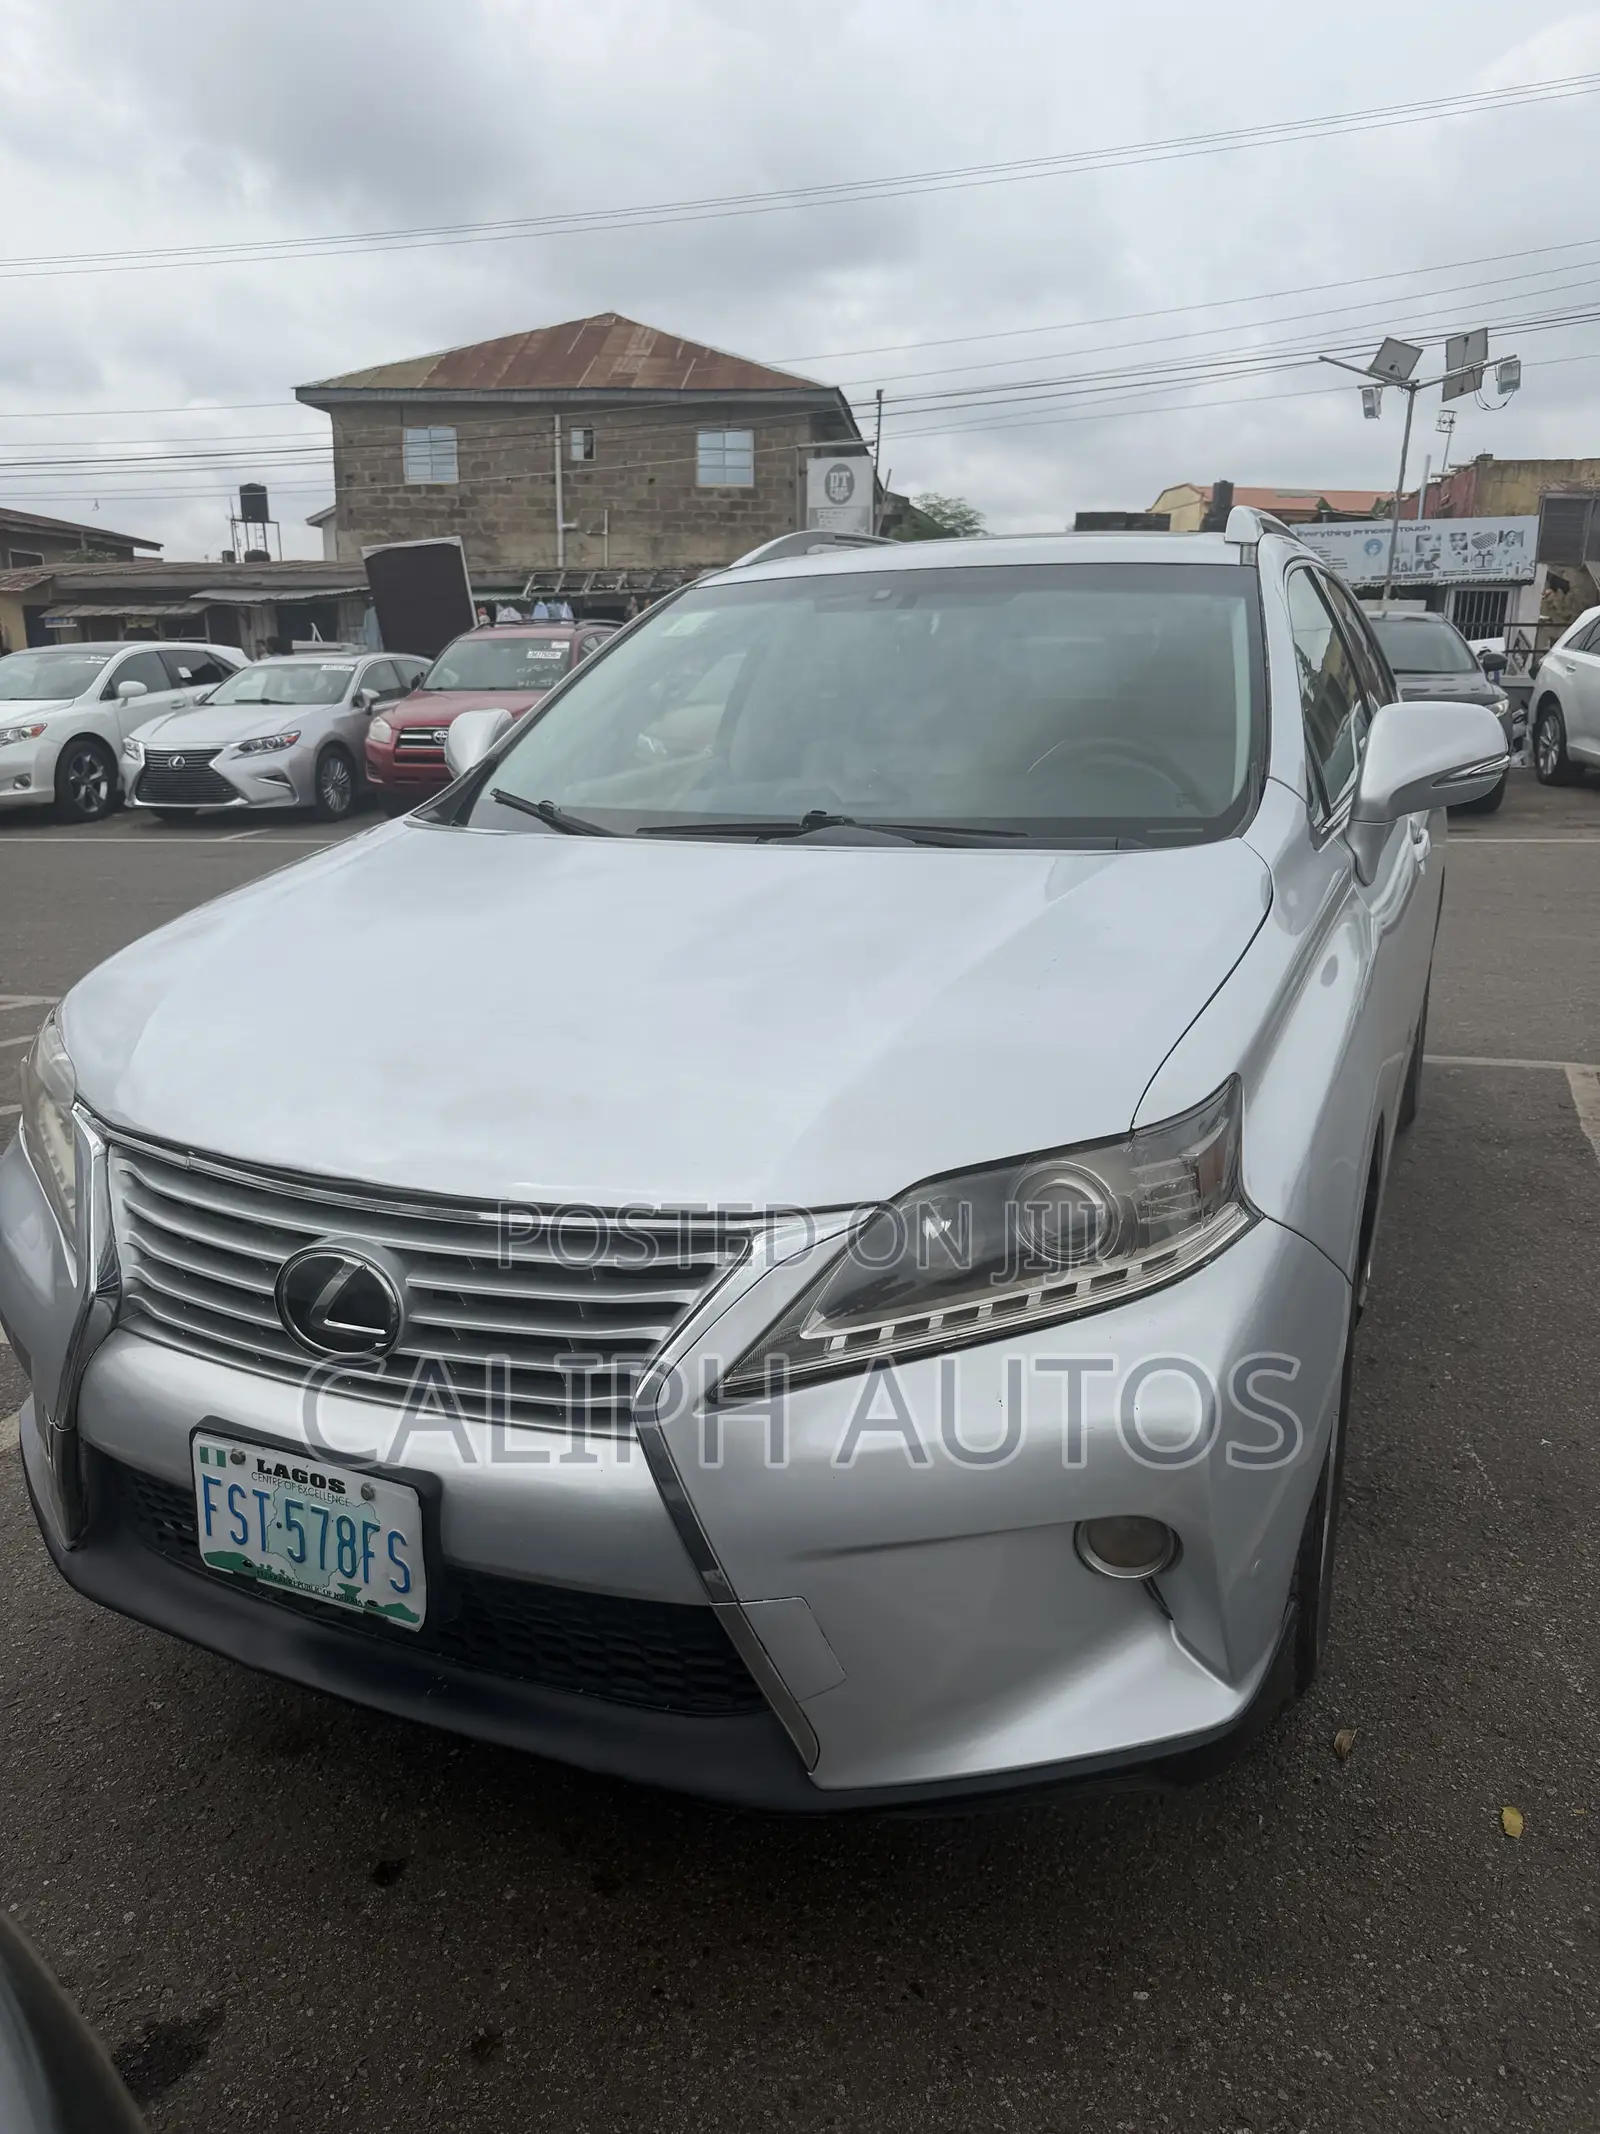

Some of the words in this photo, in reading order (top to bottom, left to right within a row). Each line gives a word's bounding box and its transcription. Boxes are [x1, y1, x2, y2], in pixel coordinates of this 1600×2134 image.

[1297, 527, 1351, 538] Everything
[1354, 528, 1397, 536] Princes
[1398, 524, 1431, 533] Touch
[251, 1471, 281, 1488] CENTRE
[284, 1480, 296, 1491] OF
[298, 1484, 350, 1507] EXCELLENCE
[257, 1458, 346, 1495] LAGOS
